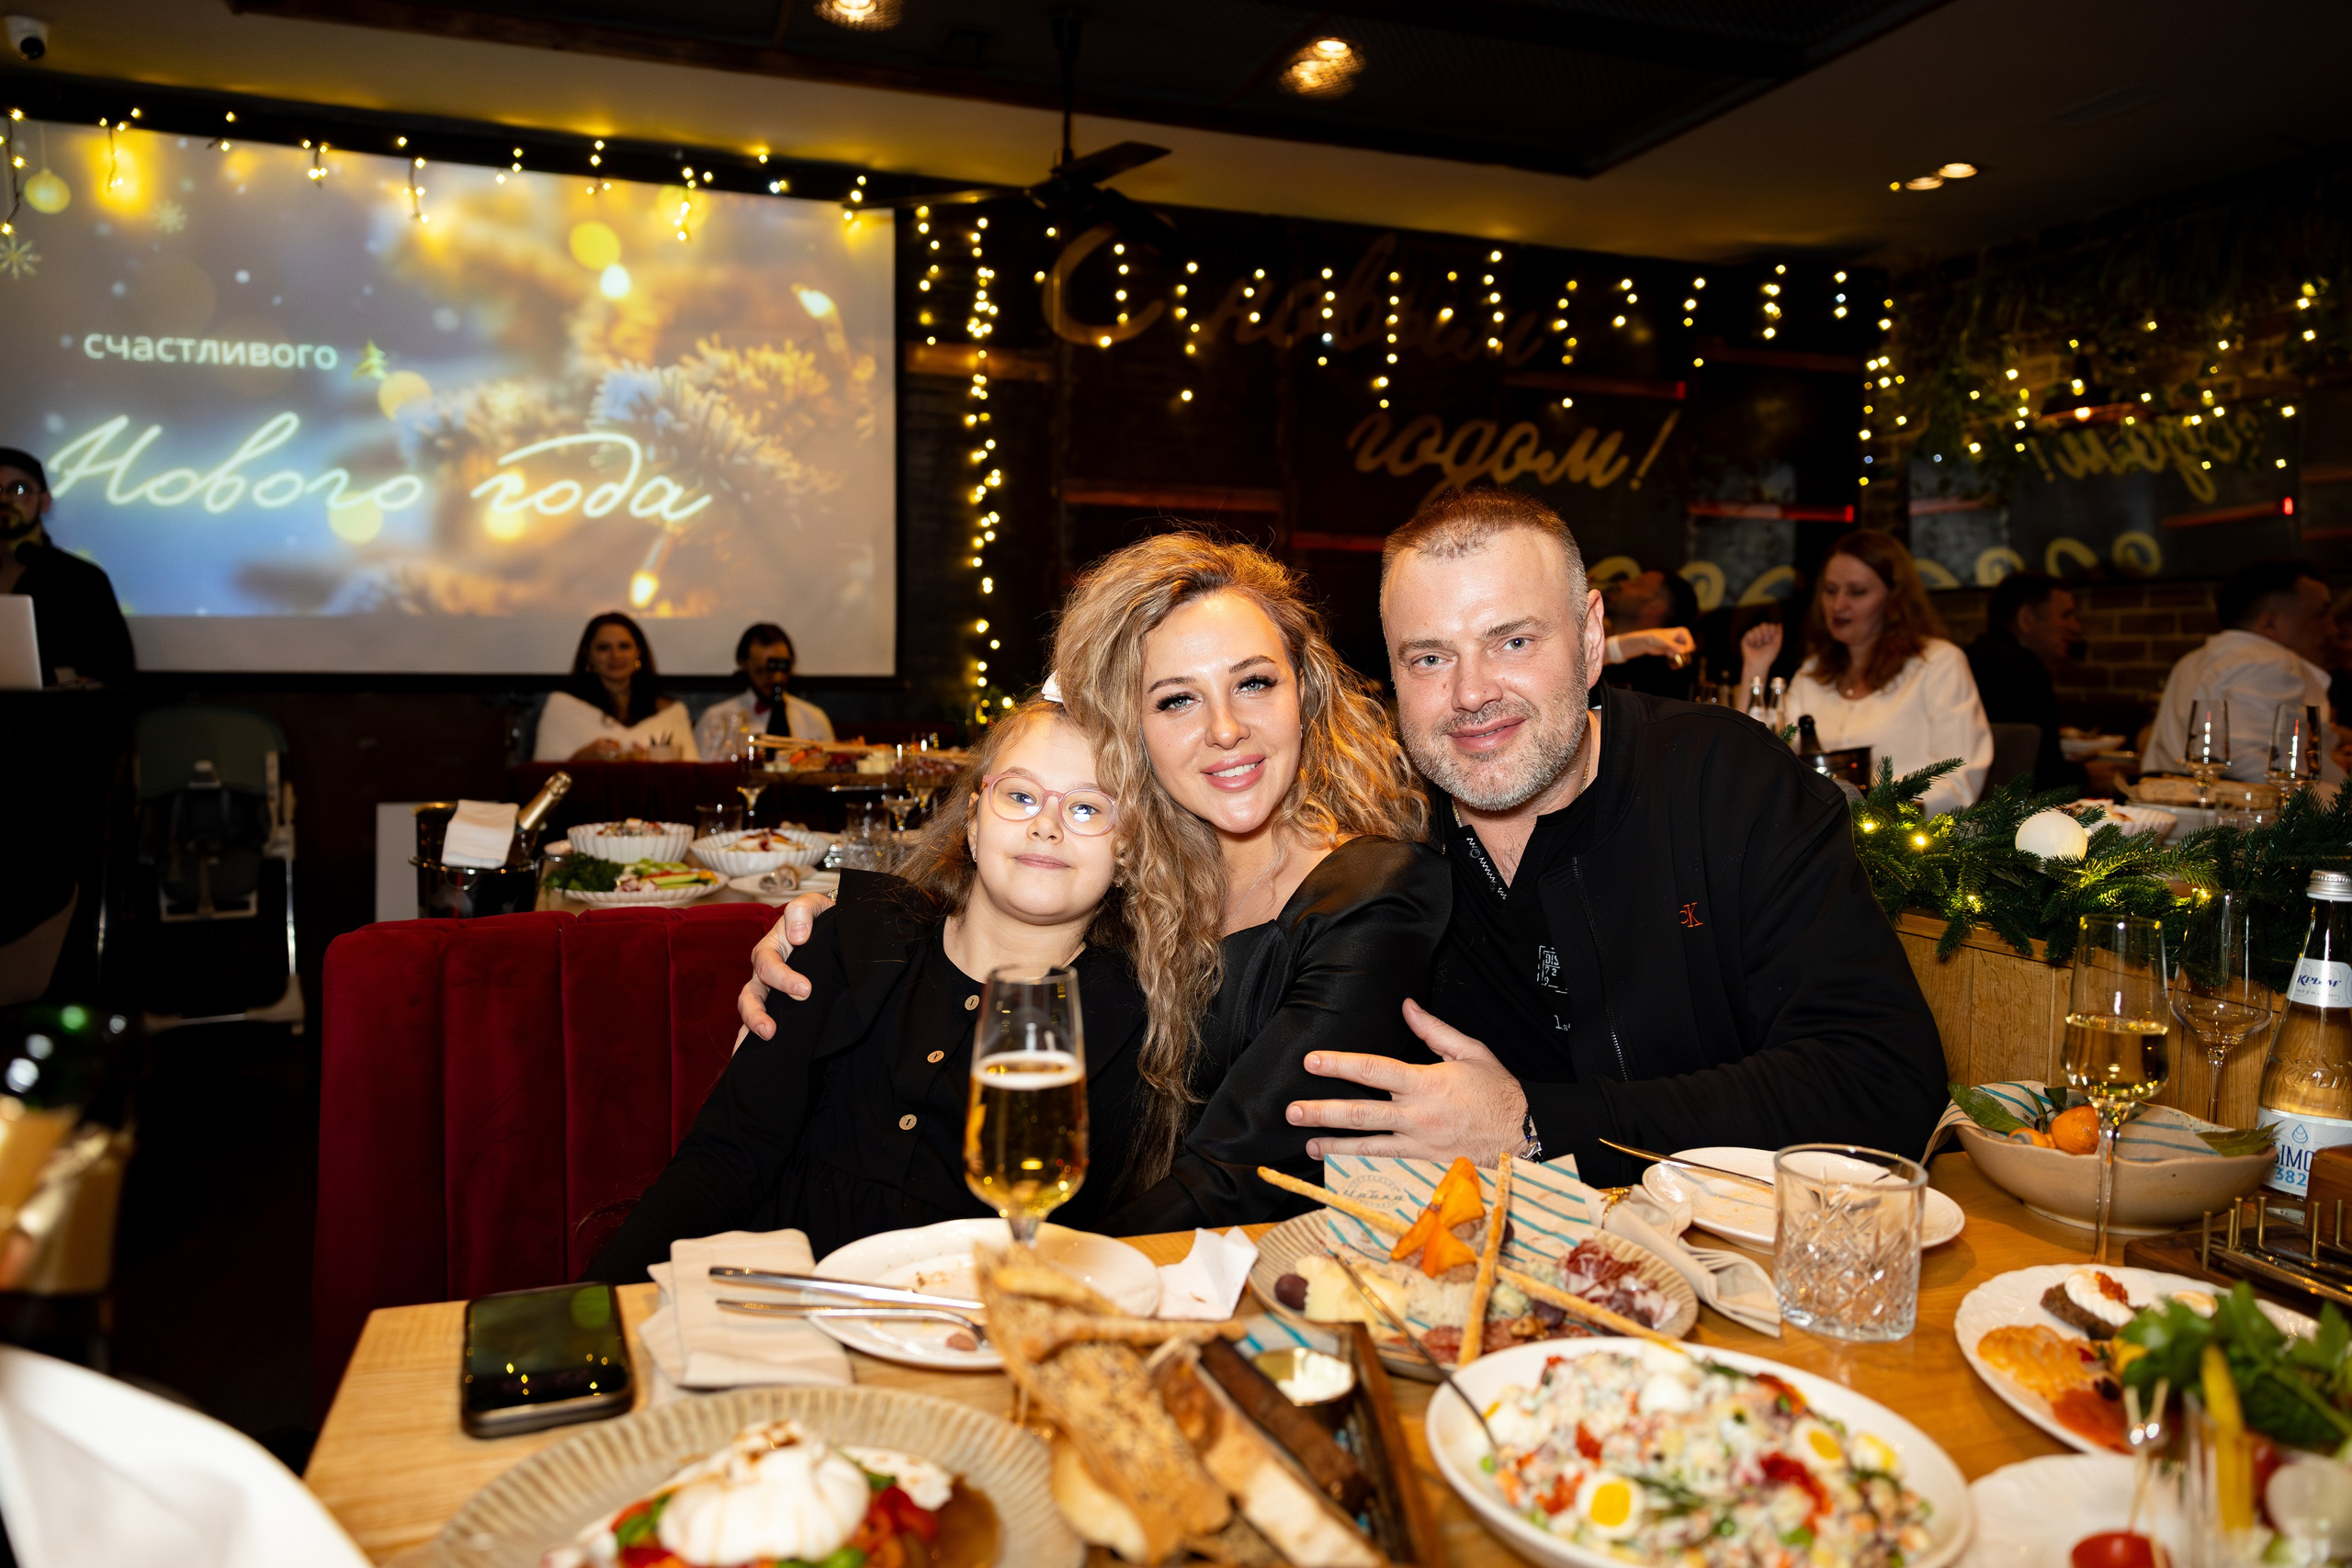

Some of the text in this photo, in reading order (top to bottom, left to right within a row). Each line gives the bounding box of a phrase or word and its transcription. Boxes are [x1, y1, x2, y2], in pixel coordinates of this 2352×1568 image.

[84, 332, 338, 369] счастливого
[48, 412, 713, 522] Нового года
[1345, 408, 1682, 511] годом!
